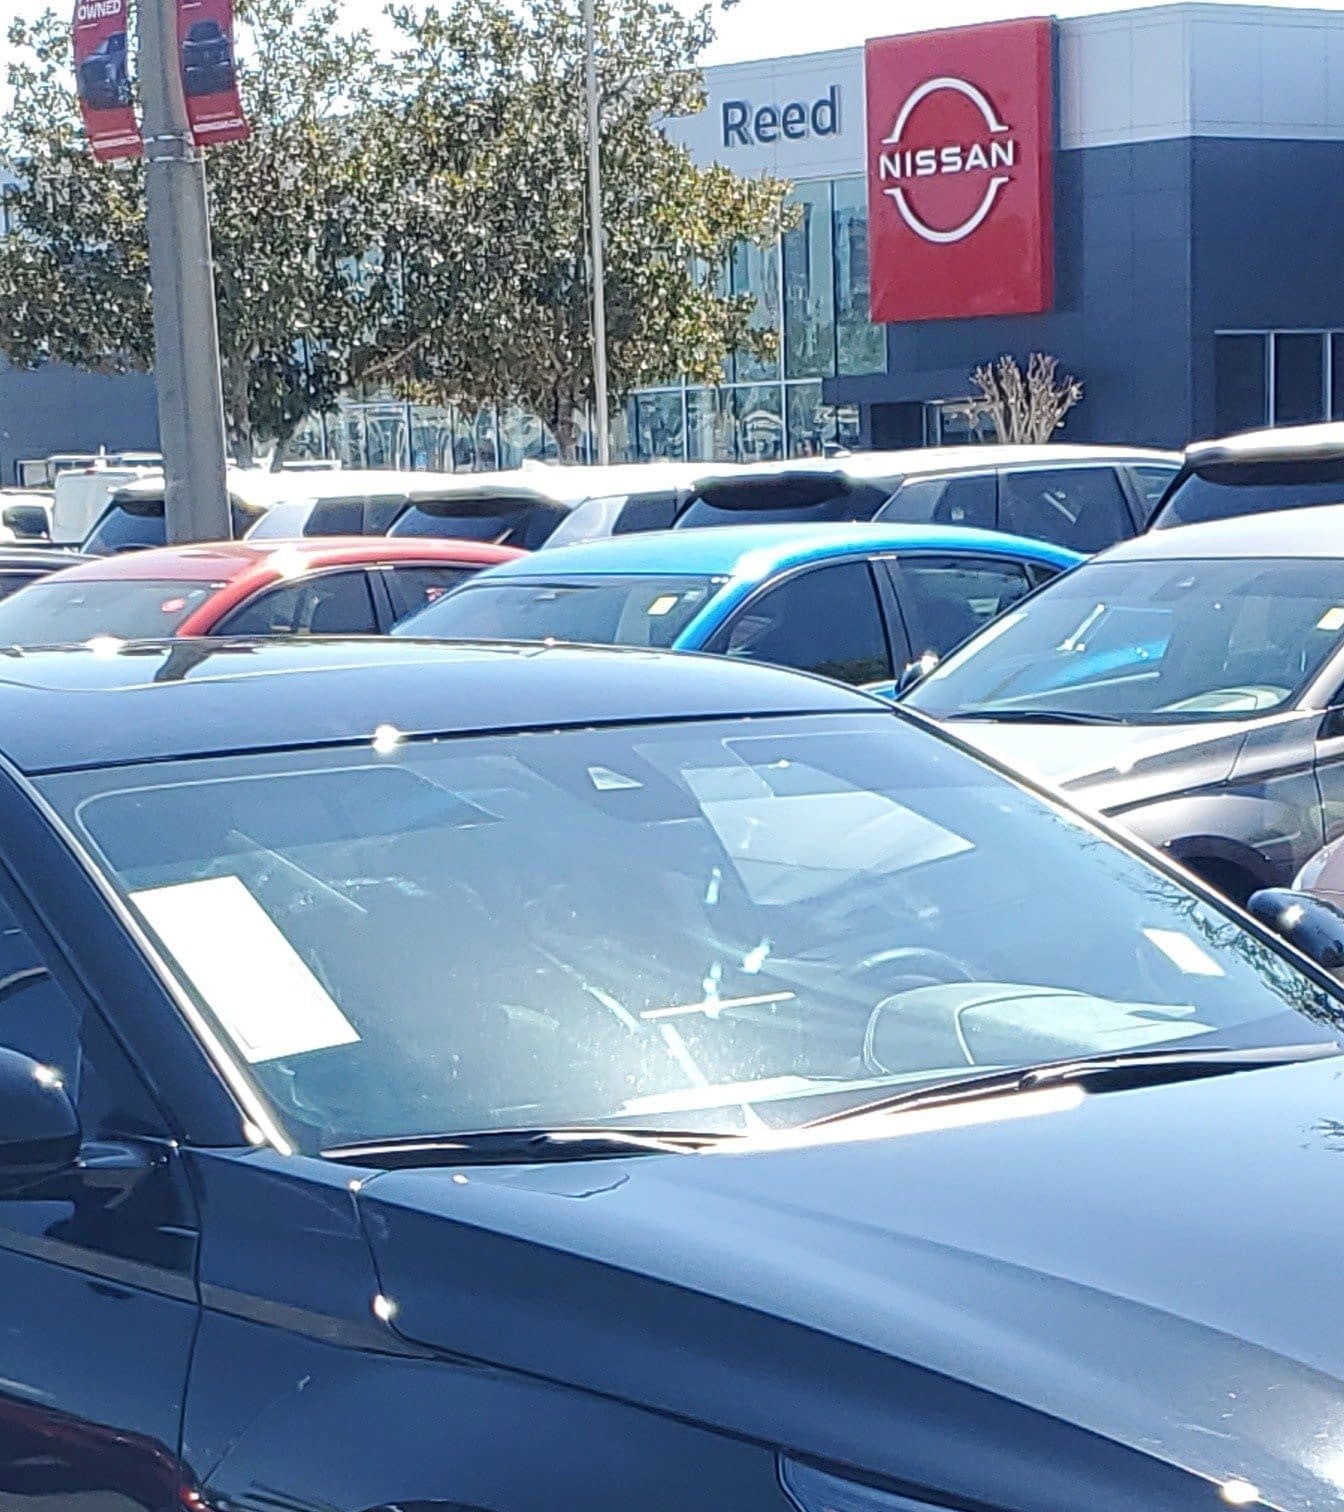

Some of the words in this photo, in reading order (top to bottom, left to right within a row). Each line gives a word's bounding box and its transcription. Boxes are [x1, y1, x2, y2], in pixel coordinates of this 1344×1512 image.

[77, 0, 122, 20] OWNED
[722, 84, 839, 148] Reed
[879, 140, 1014, 181] NISSAN
